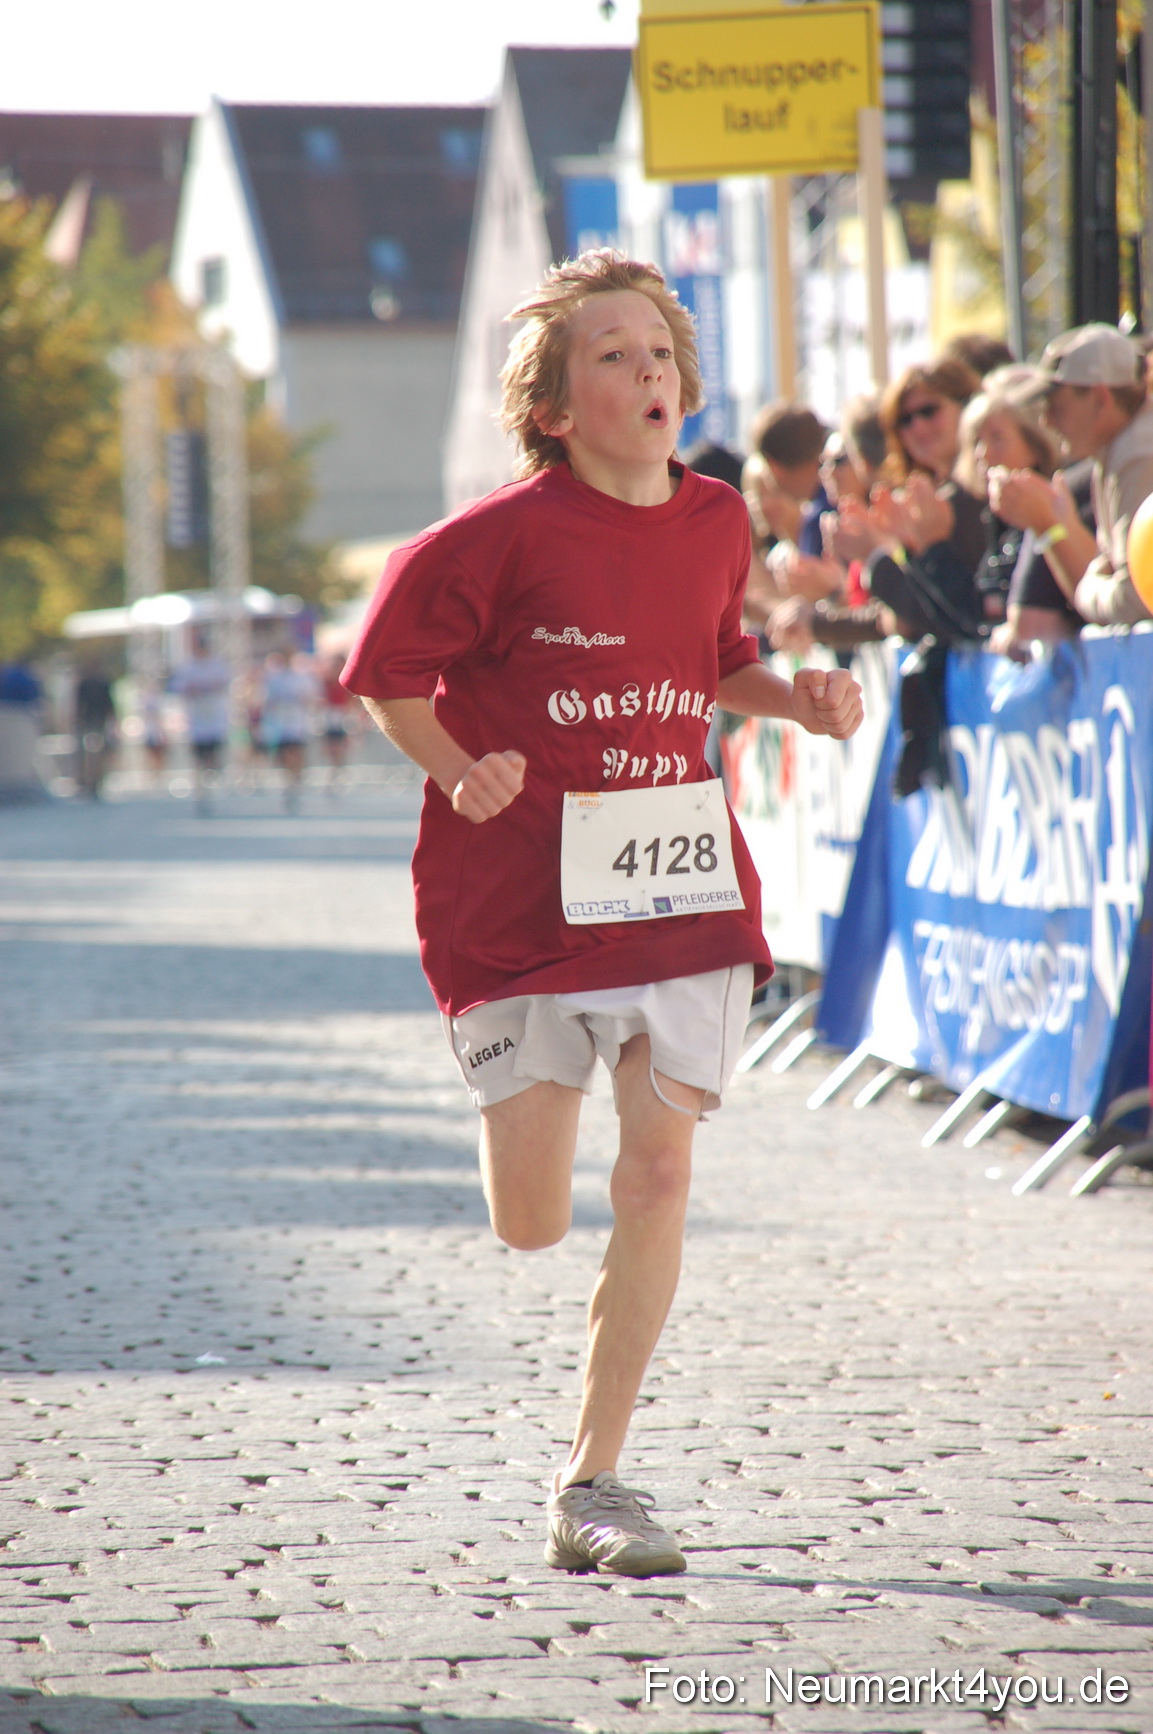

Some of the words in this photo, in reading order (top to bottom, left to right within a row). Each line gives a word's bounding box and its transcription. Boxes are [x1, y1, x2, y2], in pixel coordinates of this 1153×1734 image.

[653, 58, 858, 94] Schnupper-
[724, 100, 789, 133] lauf
[547, 679, 717, 725] Gasthaus
[602, 748, 688, 787] Rupp
[612, 833, 718, 878] 4128
[566, 900, 631, 917] BOCK
[672, 890, 739, 906] PFLEIDERER
[469, 1036, 515, 1069] LEGEA
